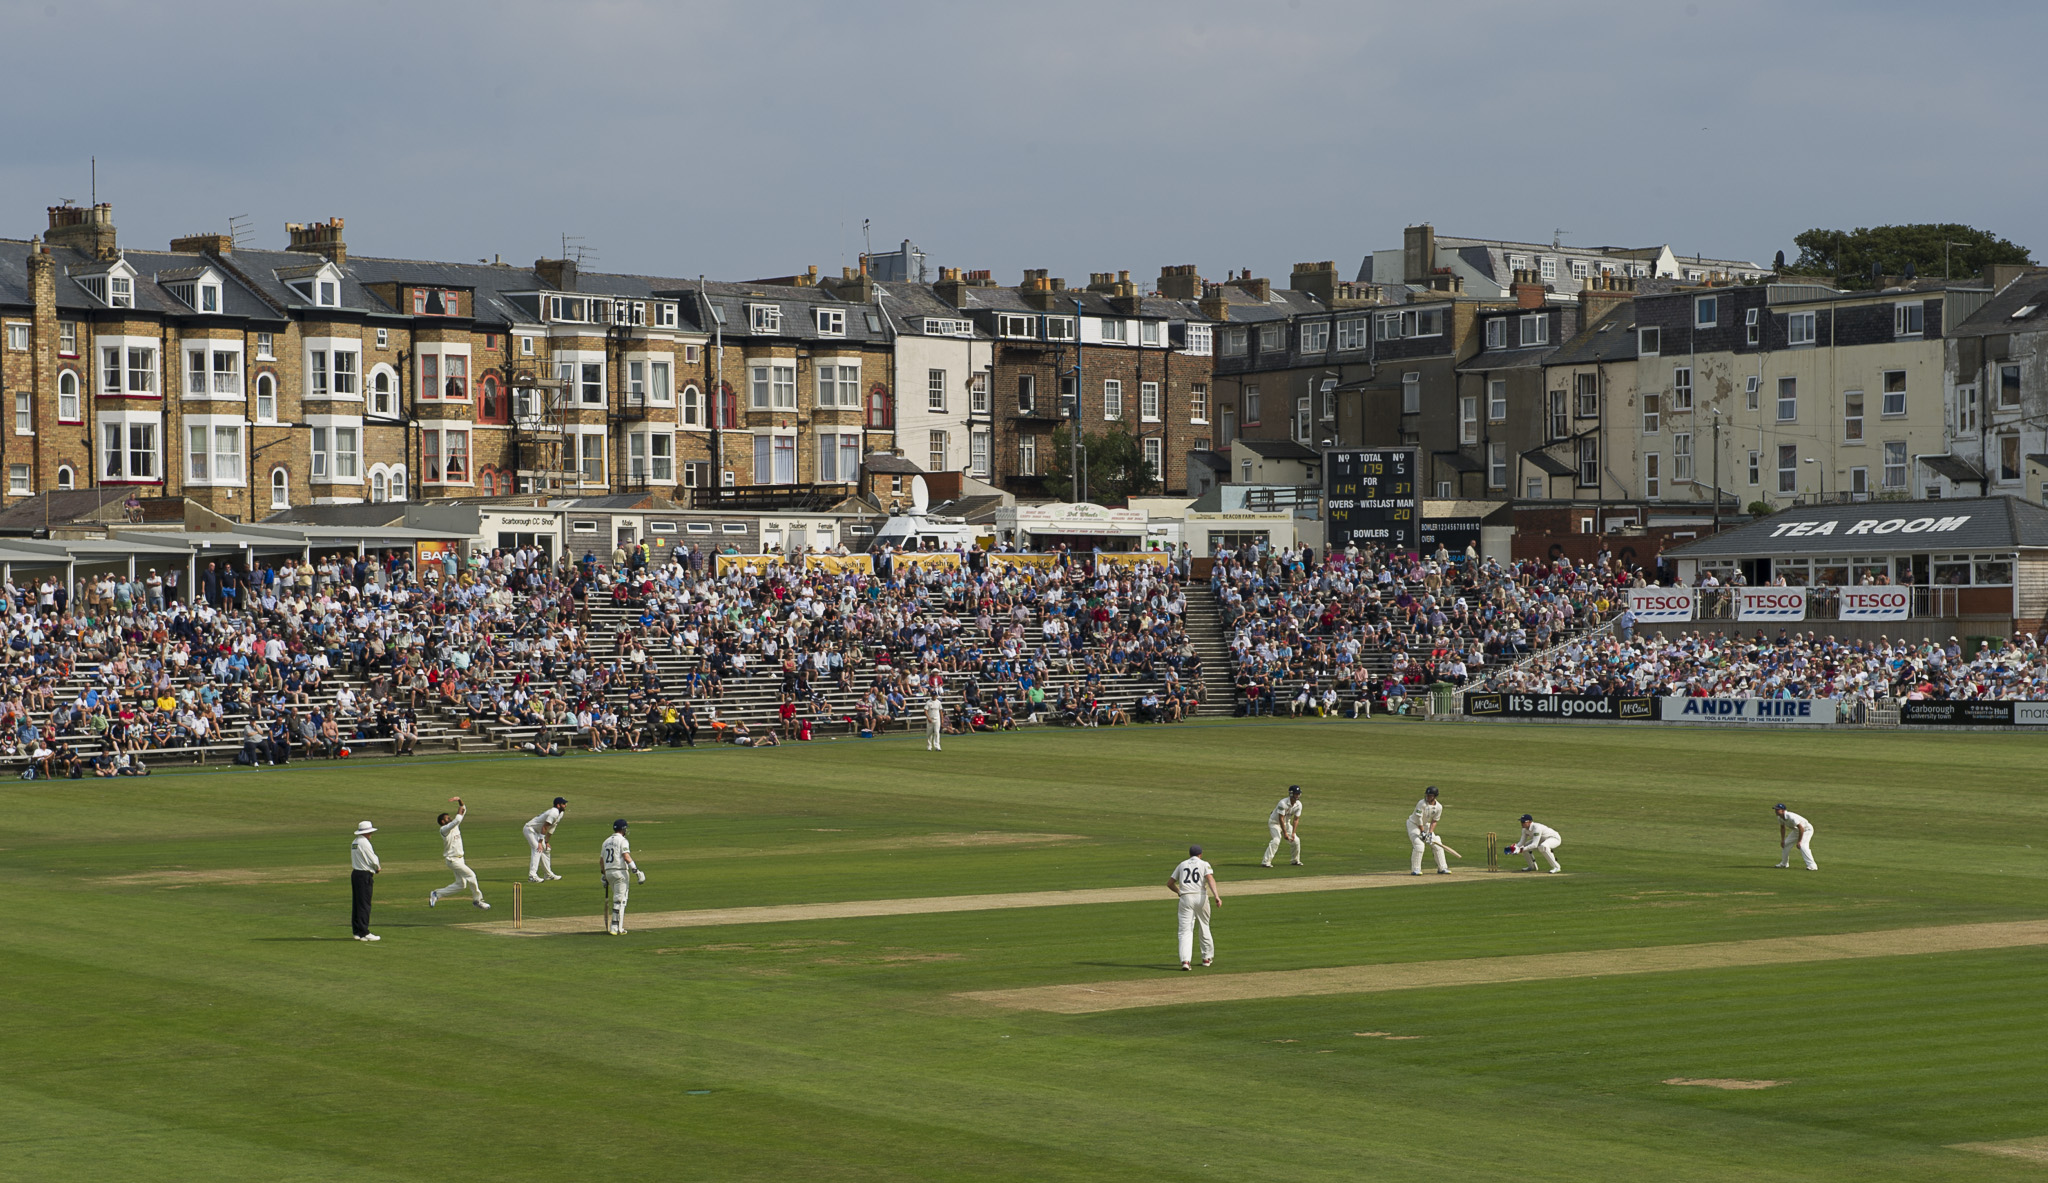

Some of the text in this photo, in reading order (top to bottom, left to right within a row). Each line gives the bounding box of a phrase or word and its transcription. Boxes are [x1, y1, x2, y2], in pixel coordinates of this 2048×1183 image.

[1360, 453, 1382, 462] TOTAL
[1363, 463, 1383, 475] 179
[1397, 463, 1404, 474] 5
[1363, 477, 1378, 486] FOR
[1336, 482, 1411, 498] 114 3 37
[1329, 499, 1414, 509] OVERS WKTS LAST MAN
[502, 516, 554, 526] Scarborough CC Shop
[1332, 509, 1410, 521] 44 20
[1769, 516, 1971, 537] TEA ROOM
[1353, 529, 1389, 538] BOWLERS
[1396, 530, 1404, 541] 9
[1633, 596, 1690, 610] TESCO
[1744, 595, 1802, 608] TESCO
[1845, 594, 1906, 608] TESCO
[1474, 700, 1499, 710] McCain
[1509, 695, 1613, 716] It's all good.
[1622, 703, 1649, 714] McCain
[1681, 699, 1811, 717] ANDY HIRE
[1911, 704, 1955, 714] carborough
[606, 848, 614, 863] 23
[1183, 867, 1200, 884] 26
